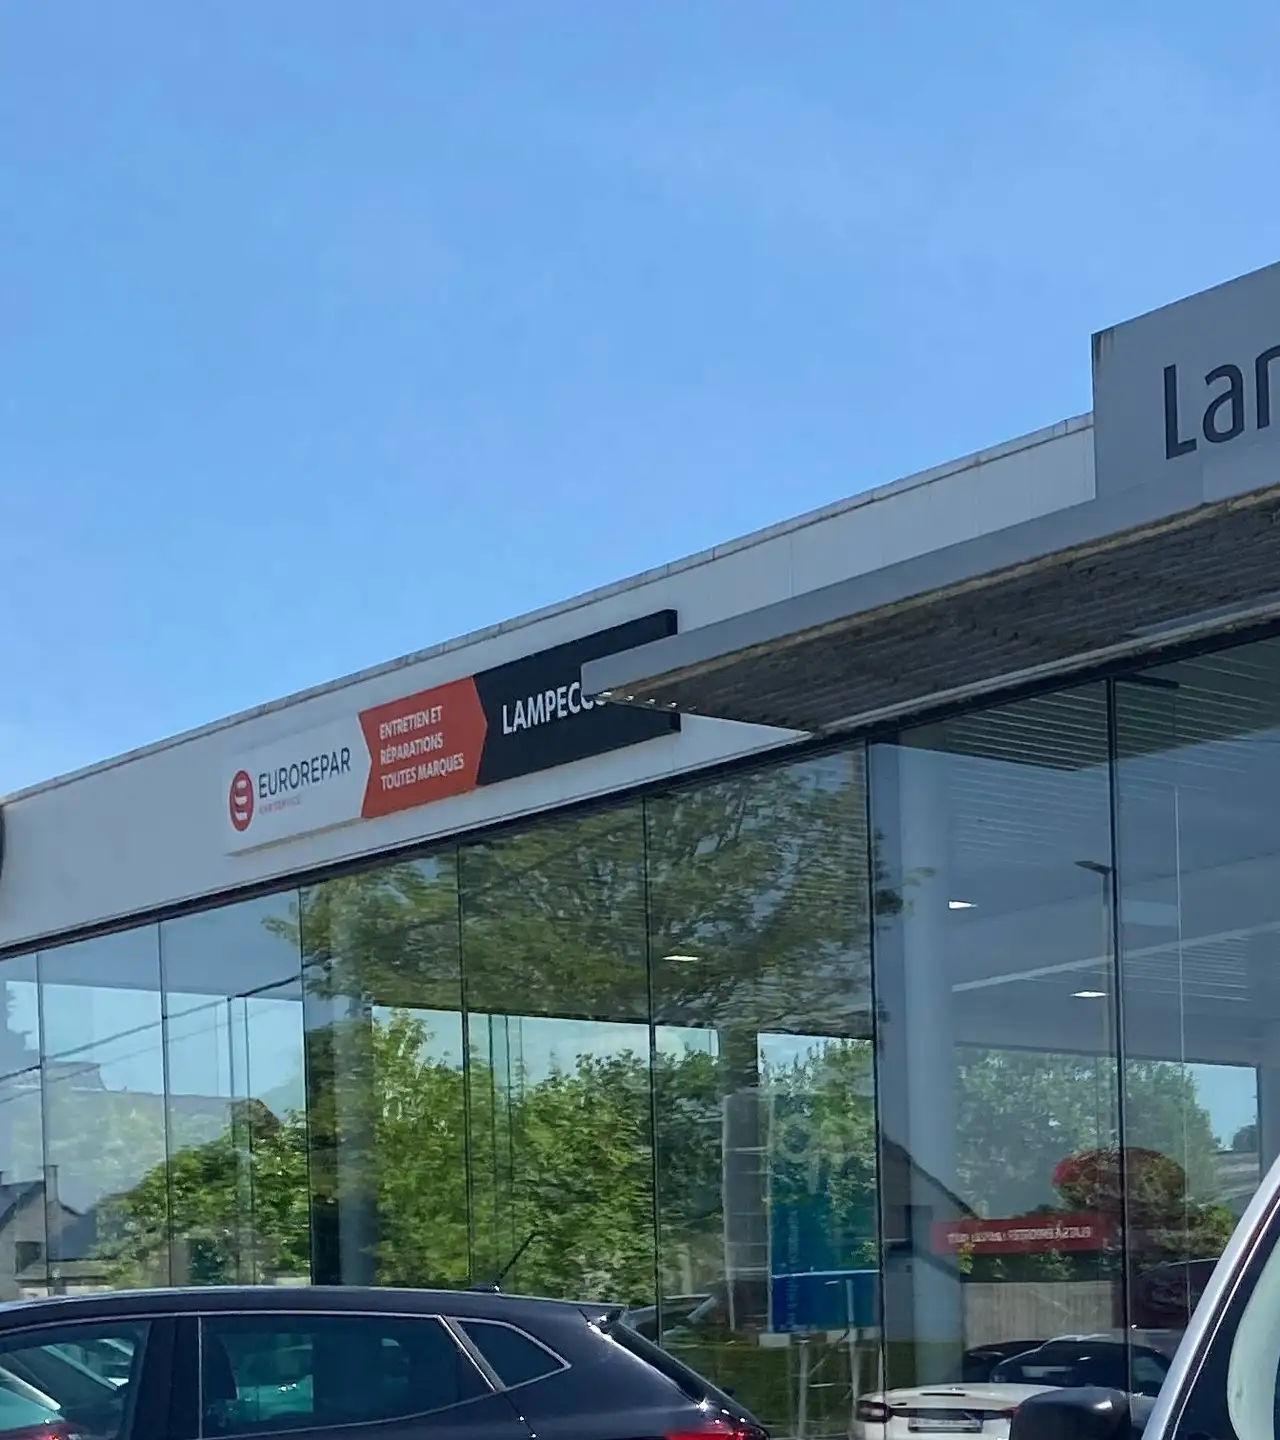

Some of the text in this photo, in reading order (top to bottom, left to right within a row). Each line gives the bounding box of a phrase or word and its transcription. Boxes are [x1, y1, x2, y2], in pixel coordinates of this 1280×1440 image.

[379, 705, 443, 741] ENTRETIEN ET
[502, 681, 606, 735] LAMPEC
[258, 746, 351, 799] EUROREPAR
[380, 752, 465, 791] TOUTES MARQUES
